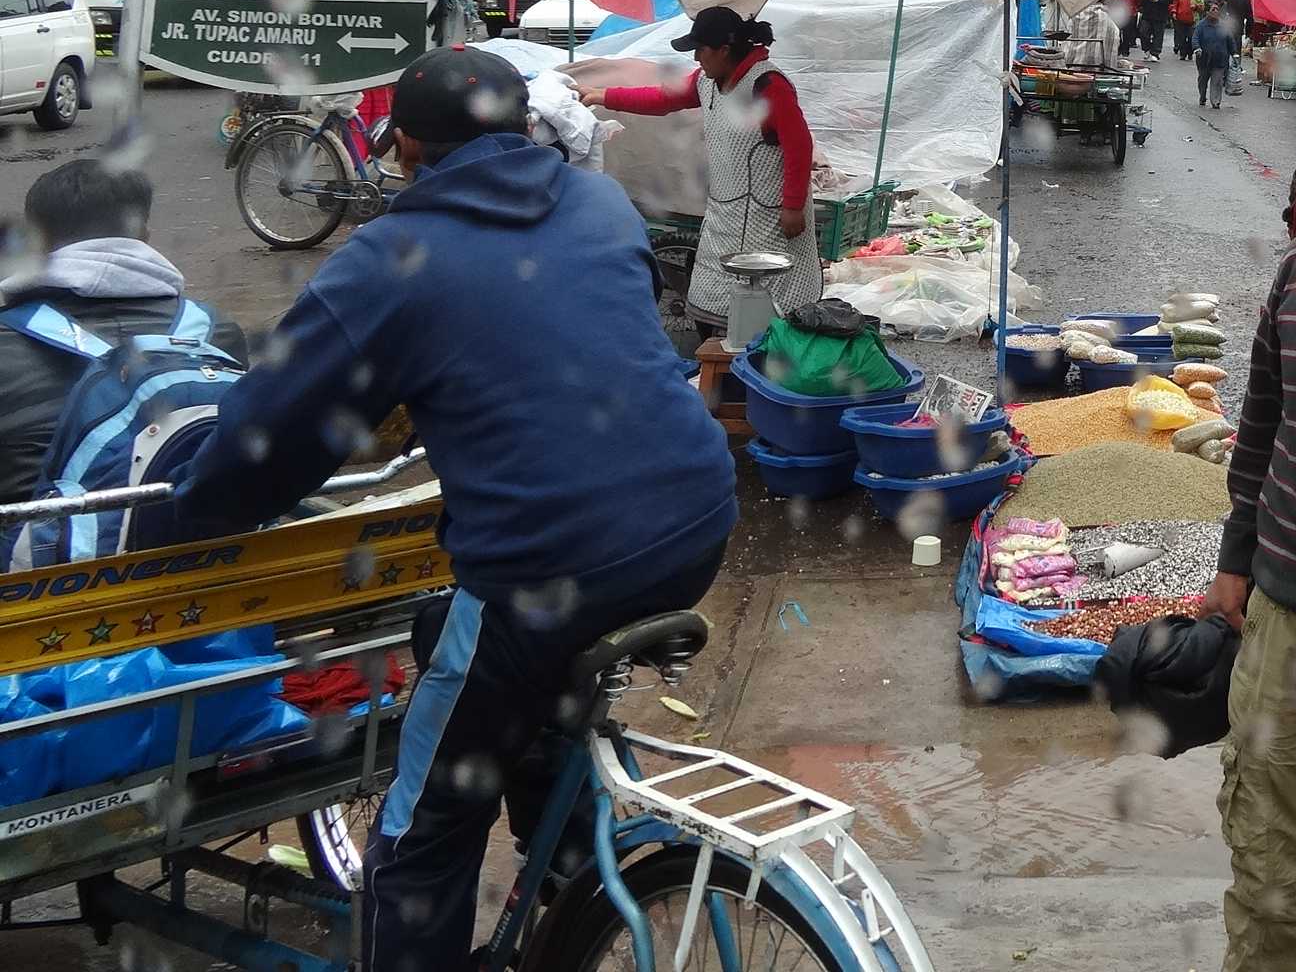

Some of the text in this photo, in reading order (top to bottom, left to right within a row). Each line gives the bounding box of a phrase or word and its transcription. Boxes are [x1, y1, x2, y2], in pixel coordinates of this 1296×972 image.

[191, 8, 383, 29] AV. SIMON BOLIVAR
[161, 22, 316, 46] JR. TUPAC AMARU
[7, 791, 133, 835] MONTANERA
